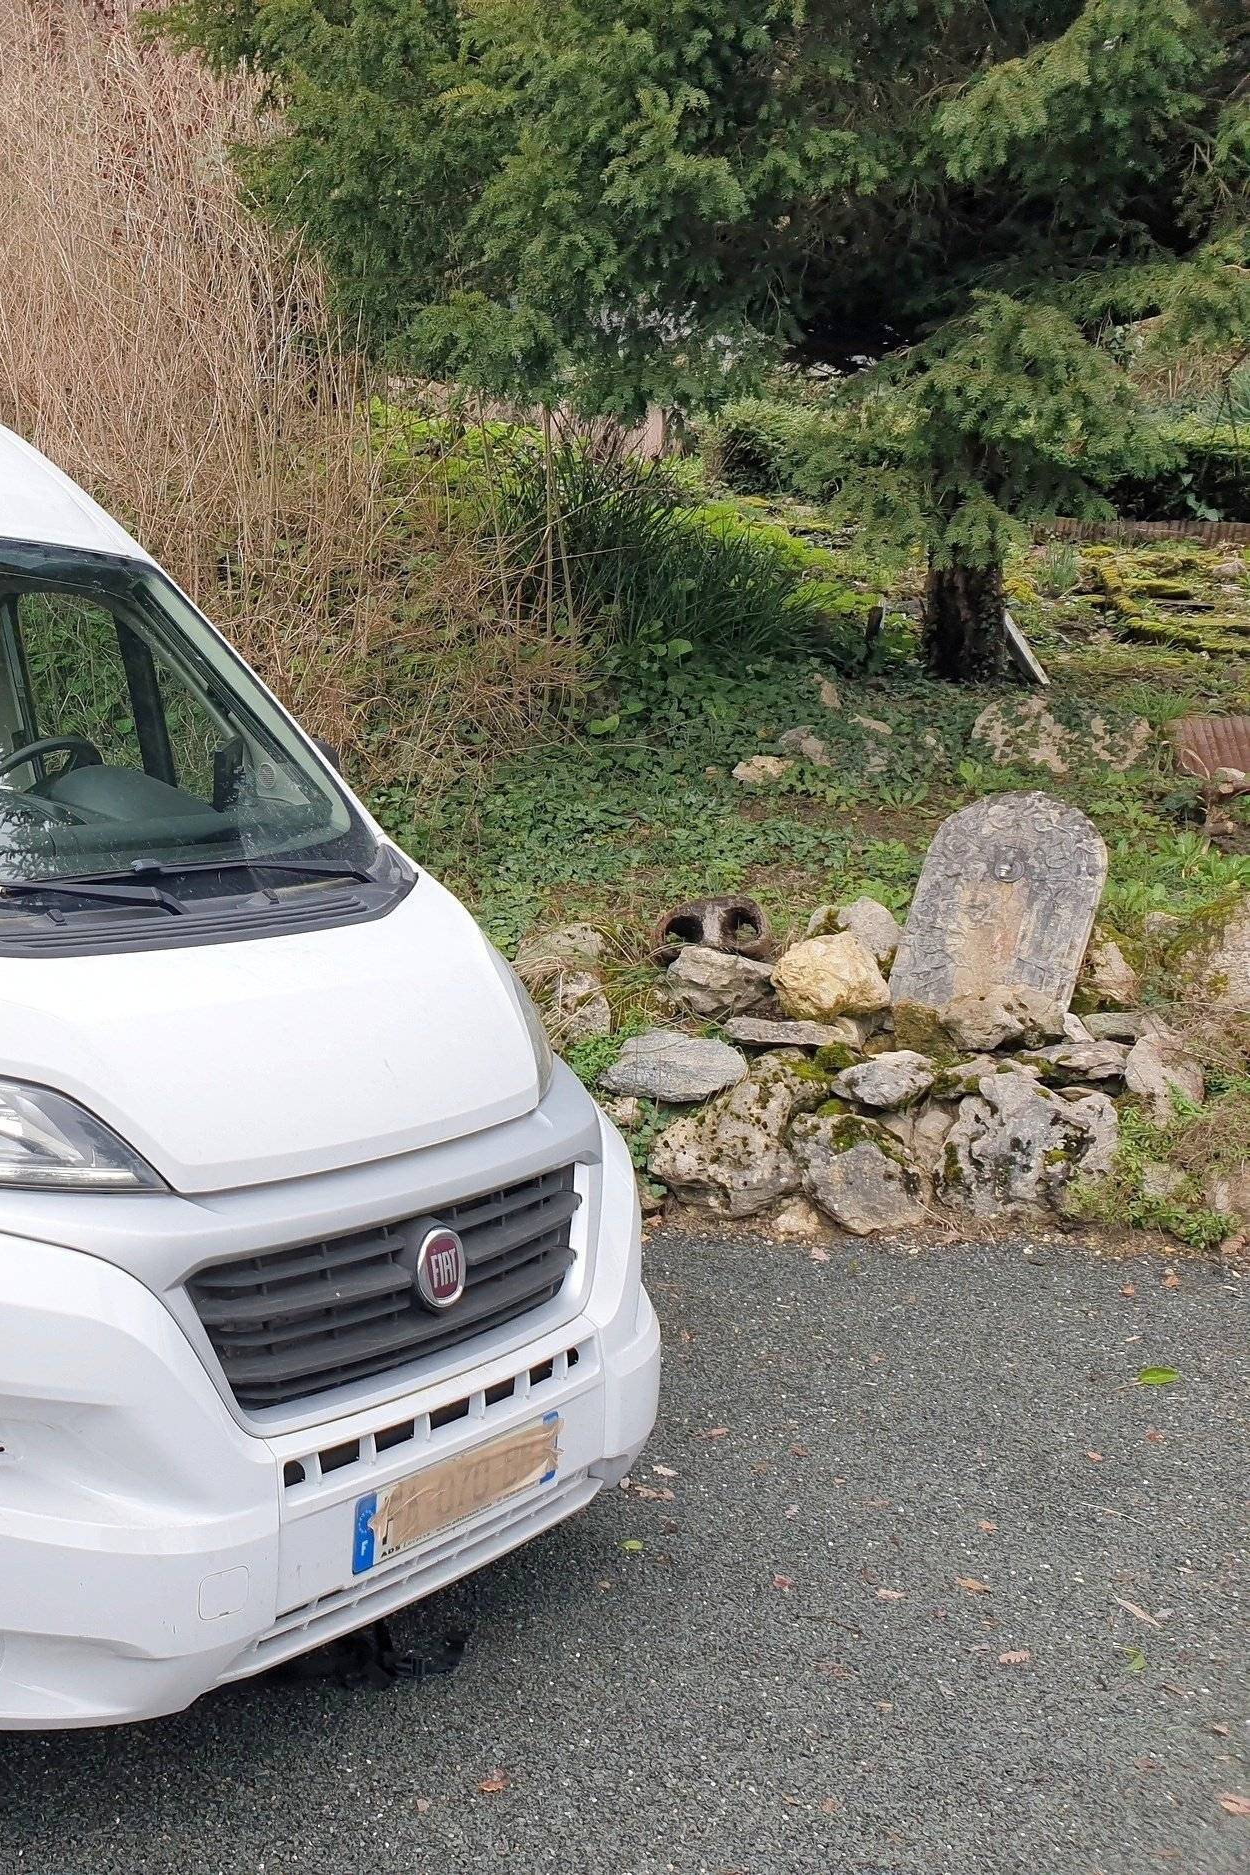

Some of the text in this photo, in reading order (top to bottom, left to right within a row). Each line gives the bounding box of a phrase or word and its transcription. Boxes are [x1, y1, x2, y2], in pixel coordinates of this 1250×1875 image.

[430, 1248, 457, 1289] FIAT
[360, 1539, 369, 1557] F
[380, 1544, 402, 1558] ADS
